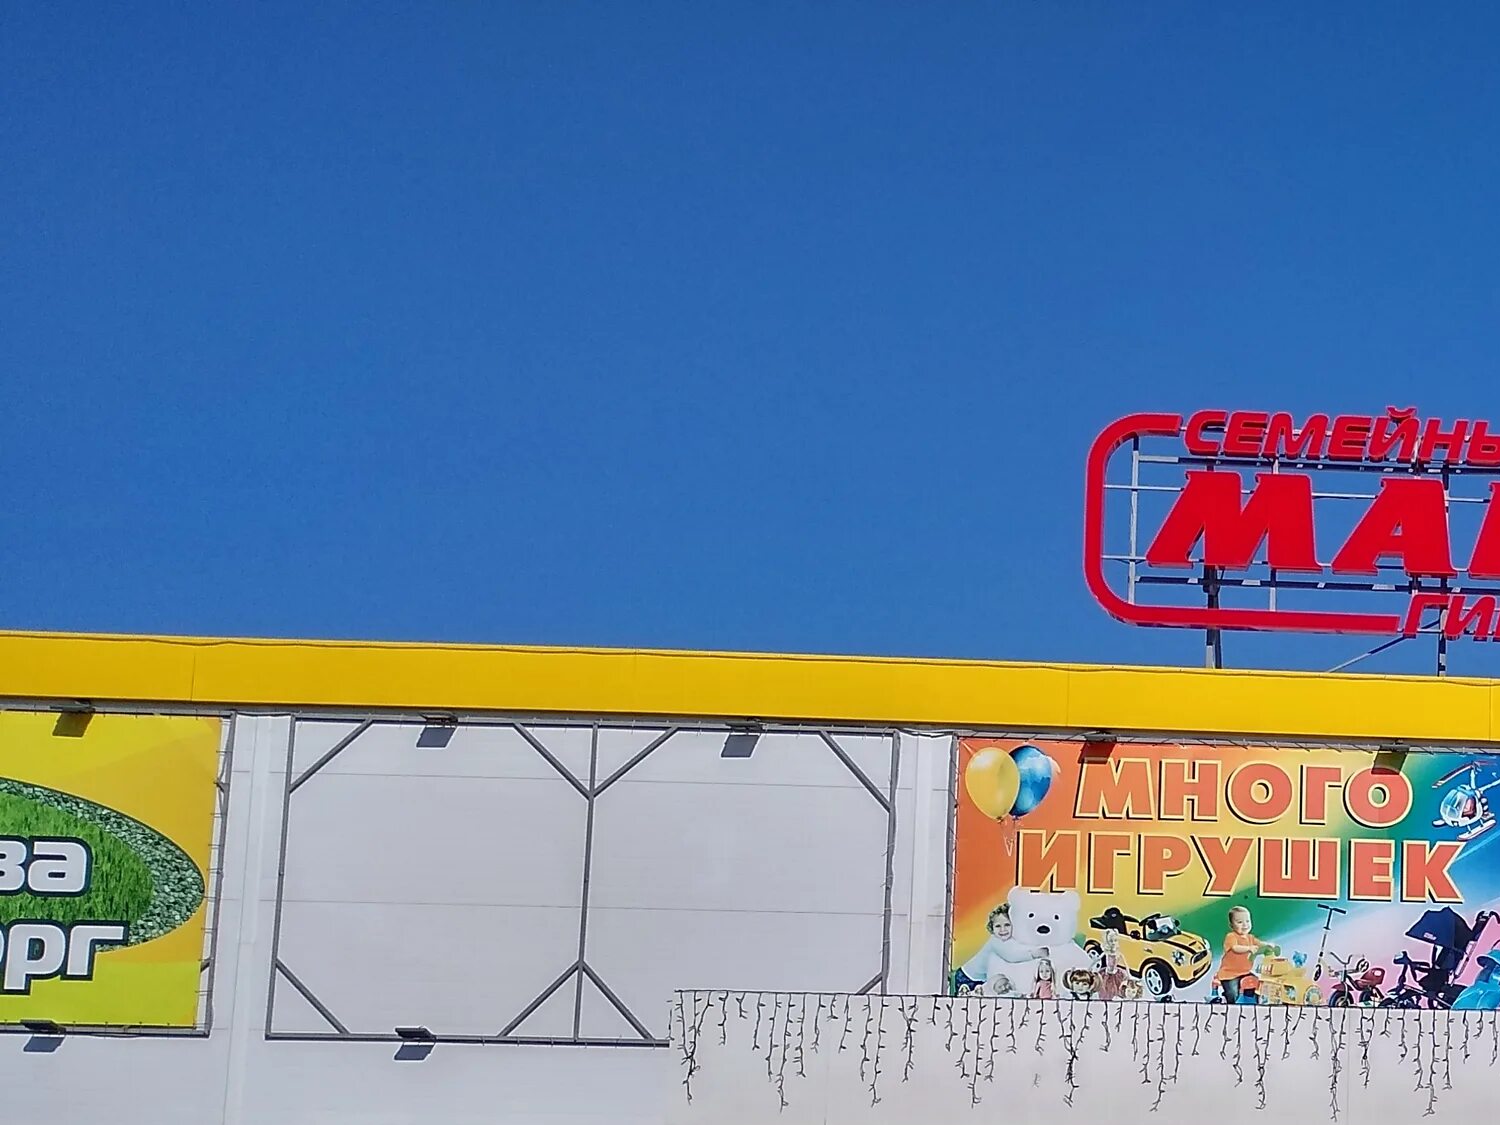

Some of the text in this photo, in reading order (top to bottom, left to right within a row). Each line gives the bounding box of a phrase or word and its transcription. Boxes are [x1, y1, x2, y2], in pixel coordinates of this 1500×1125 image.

[1073, 757, 1412, 828] МНОГО
[1015, 829, 1465, 904] ИГРУШЕК
[0, 921, 128, 994] рг
